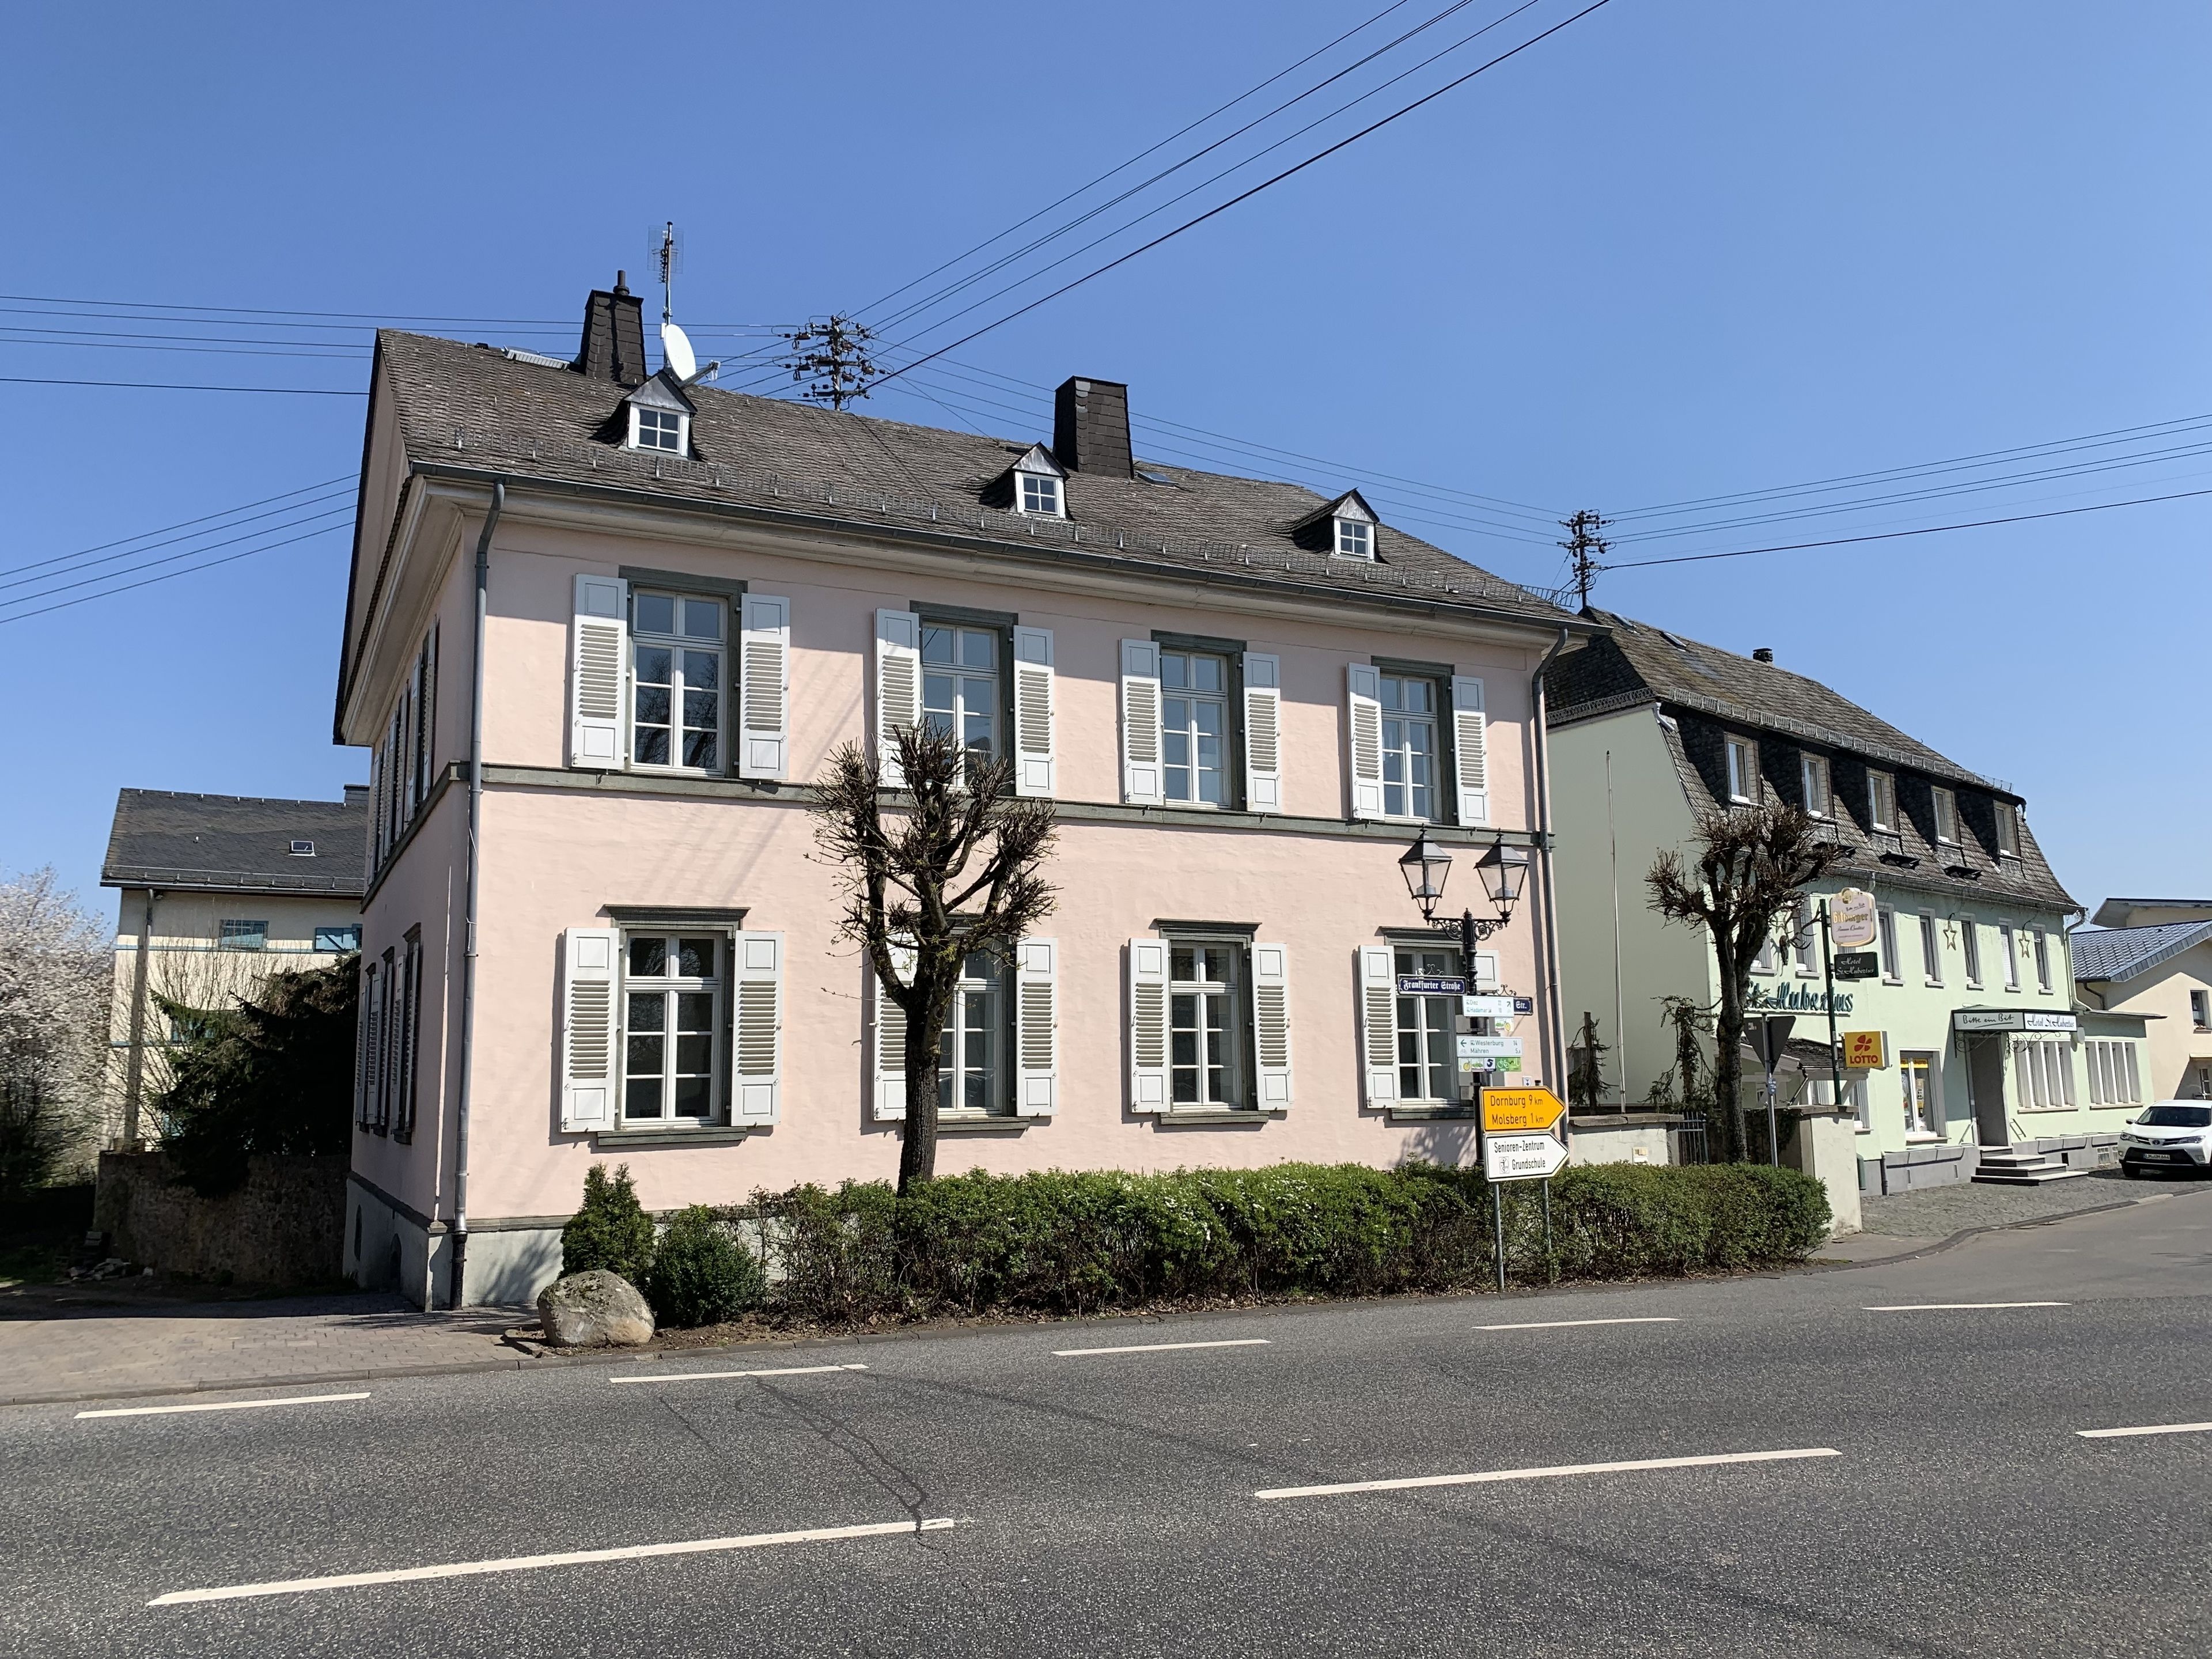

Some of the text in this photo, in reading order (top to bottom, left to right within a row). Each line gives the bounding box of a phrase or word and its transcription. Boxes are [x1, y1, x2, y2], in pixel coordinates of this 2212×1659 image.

[1403, 980, 1460, 991] Frankfurter Straße
[1963, 1015, 1981, 1024] Bitte
[1998, 1013, 2014, 1021] Bit
[2027, 1014, 2043, 1027] Hotel
[1850, 1055, 1878, 1064] LOTTO
[1490, 1094, 1526, 1108] Dornburg
[1528, 1094, 1533, 1105] 9
[1492, 1113, 1544, 1126] Molsberg 1 km
[1494, 1141, 1545, 1153] Senioren-Zentrum
[1512, 1157, 1546, 1170] Grundschule
